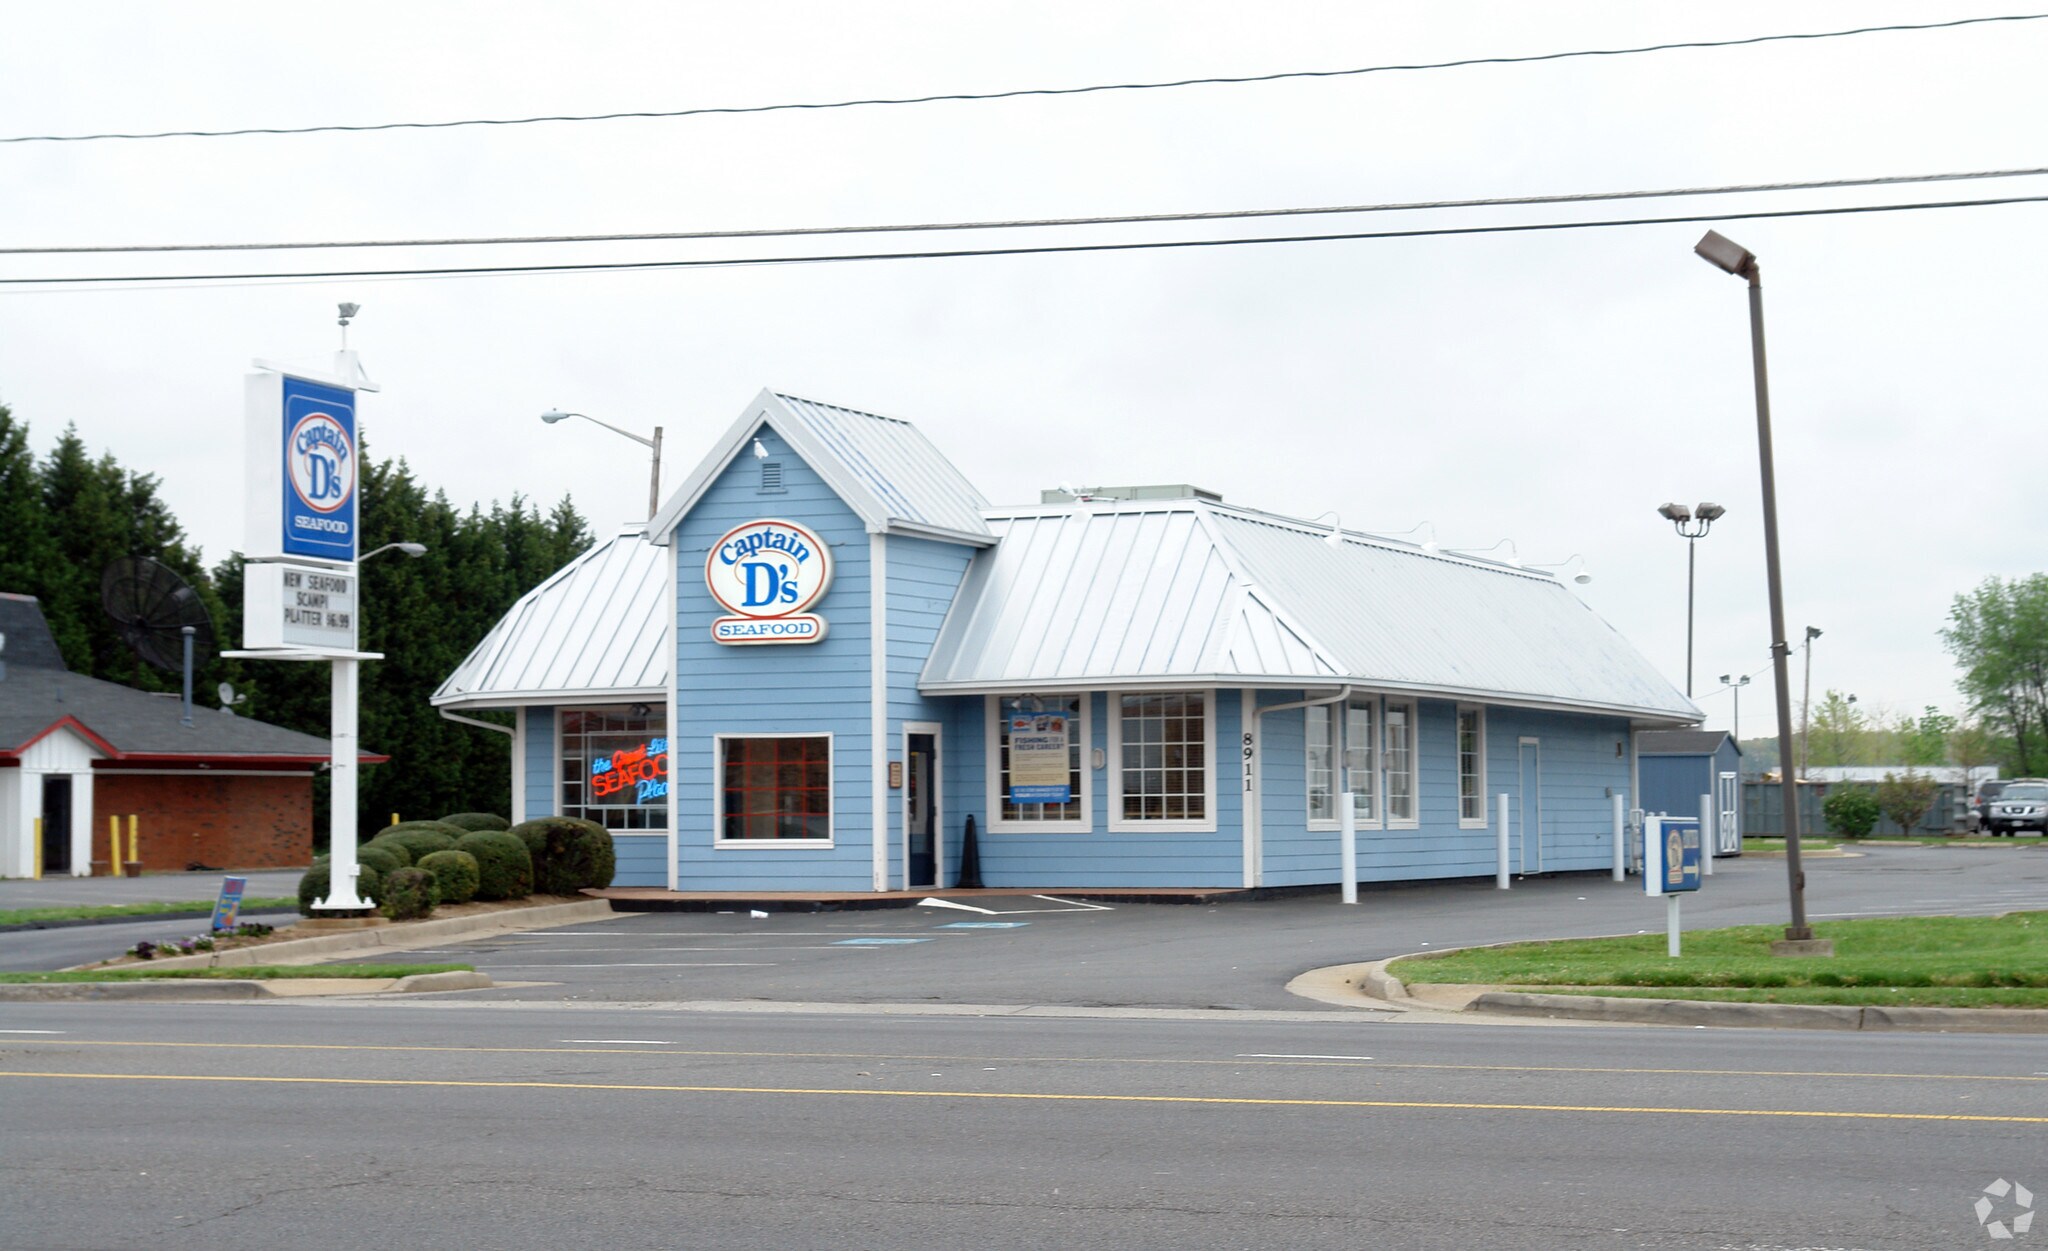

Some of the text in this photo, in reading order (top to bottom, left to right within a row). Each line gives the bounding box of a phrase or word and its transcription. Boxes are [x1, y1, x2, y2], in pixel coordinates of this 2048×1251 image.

[296, 421, 347, 465] Captain
[308, 453, 341, 500] D's
[294, 515, 348, 534] SEAFOOD
[719, 527, 810, 565] Captain
[308, 575, 347, 593] SEAFOOD
[741, 562, 798, 607] D's
[284, 608, 321, 626] PLATTER
[719, 623, 812, 636] SEAFOOD
[591, 754, 667, 796] SEAFOO
[1243, 732, 1253, 791] 8911
